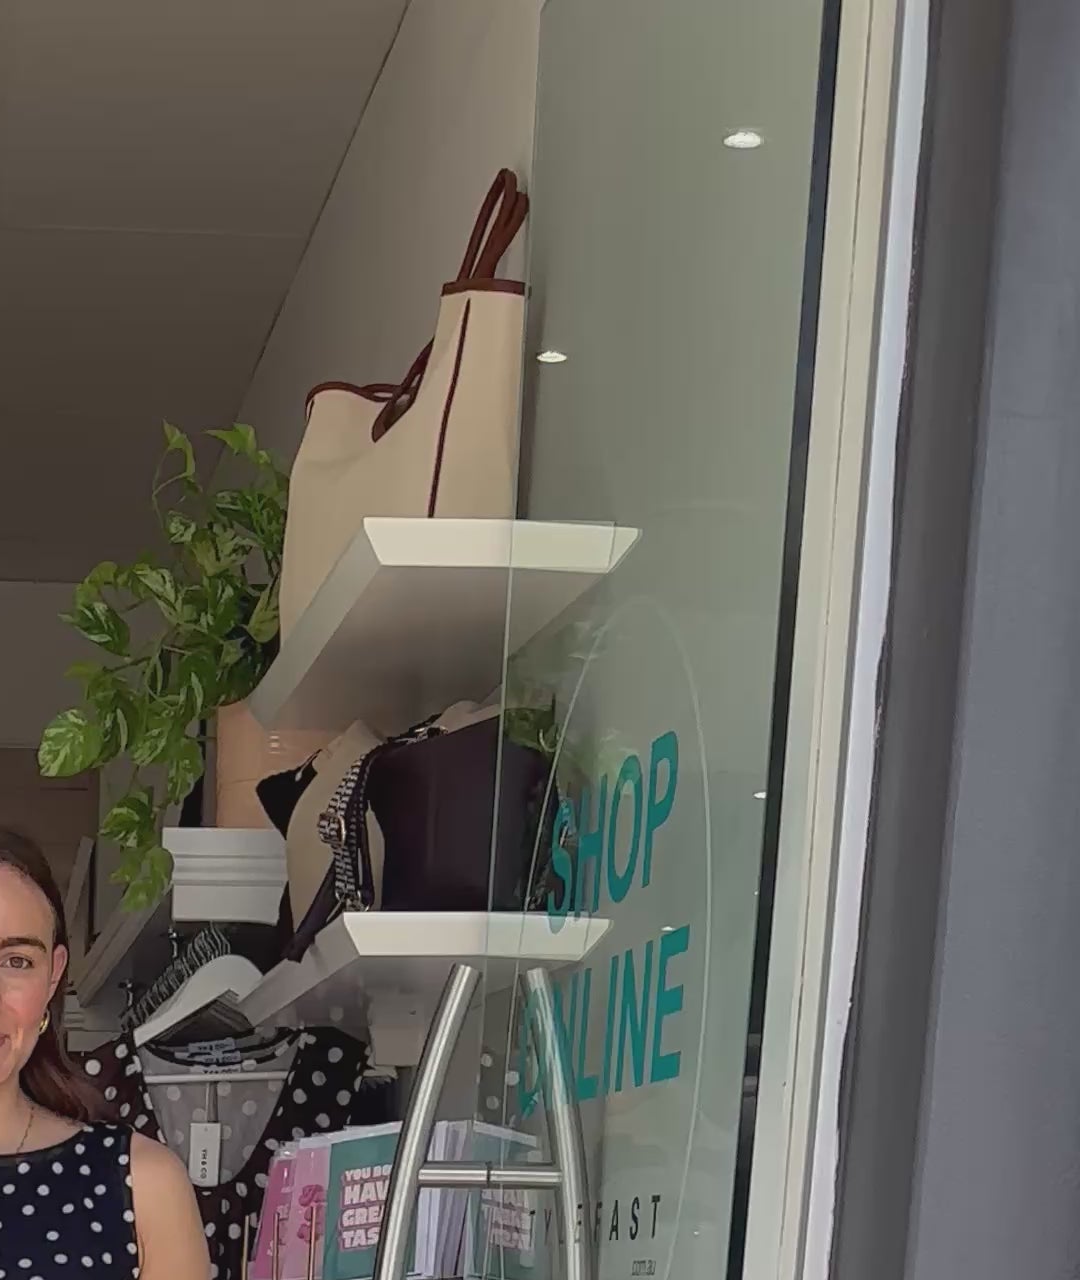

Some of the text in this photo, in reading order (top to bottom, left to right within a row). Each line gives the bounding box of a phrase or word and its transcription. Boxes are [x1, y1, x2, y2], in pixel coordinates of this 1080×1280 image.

[547, 731, 679, 931] SHOP
[517, 924, 690, 1119] ONLINE
[345, 1166, 371, 1181] YOU
